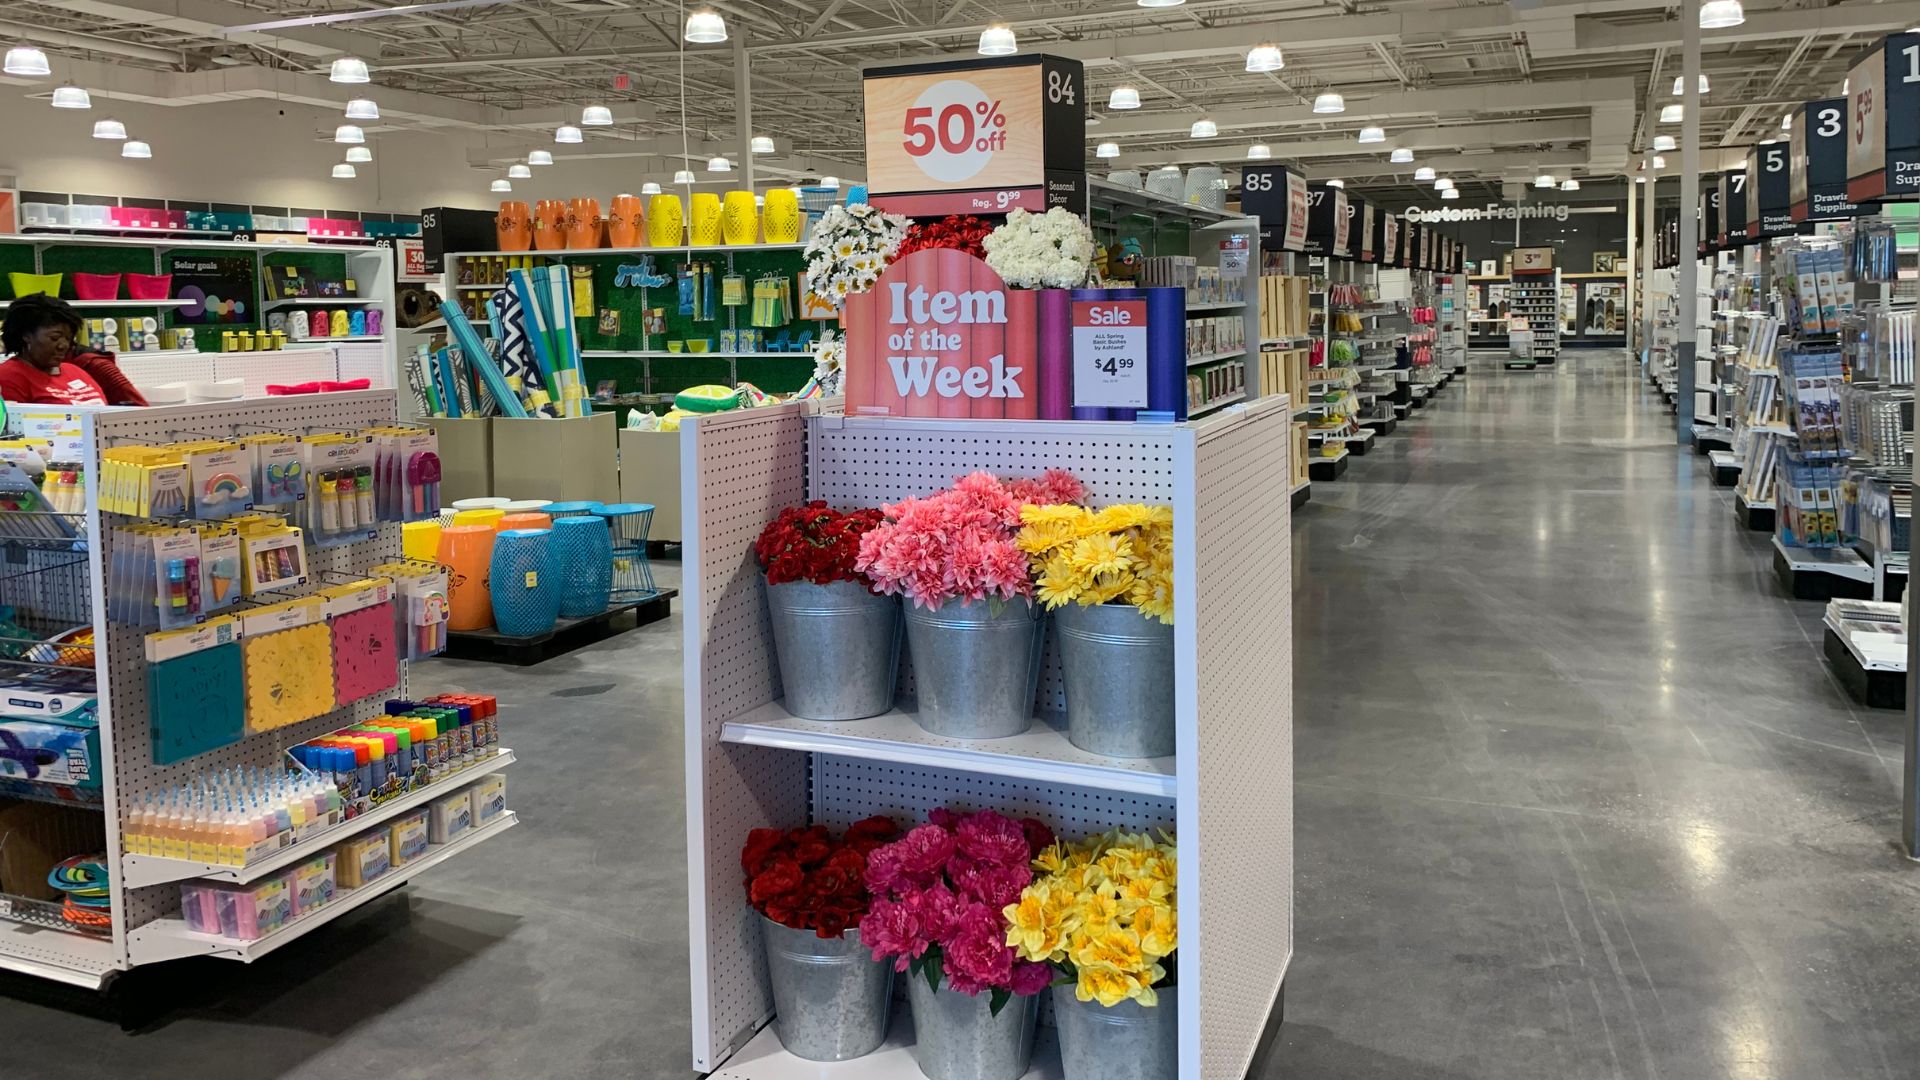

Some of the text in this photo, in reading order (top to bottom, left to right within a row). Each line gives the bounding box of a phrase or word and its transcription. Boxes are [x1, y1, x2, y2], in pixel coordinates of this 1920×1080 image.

[1048, 70, 1075, 105] 84
[903, 100, 1006, 157] 50%
[1817, 108, 1841, 137] 3
[975, 131, 1007, 152] off
[1766, 150, 1784, 172] 5
[1049, 180, 1075, 191] Seasonal
[1245, 173, 1273, 191] 85
[1731, 175, 1746, 193] 7
[972, 198, 992, 208] Reg.
[1049, 193, 1068, 203] Décor
[1814, 202, 1858, 213] Supplies
[423, 214, 436, 228] 85
[1404, 202, 1569, 223] Custom Framing
[174, 261, 217, 271] Solar goals
[411, 251, 424, 263] 30
[888, 282, 1008, 324] Item
[1089, 306, 1131, 325] Sale
[888, 327, 962, 351] of the
[887, 354, 1024, 398] Week
